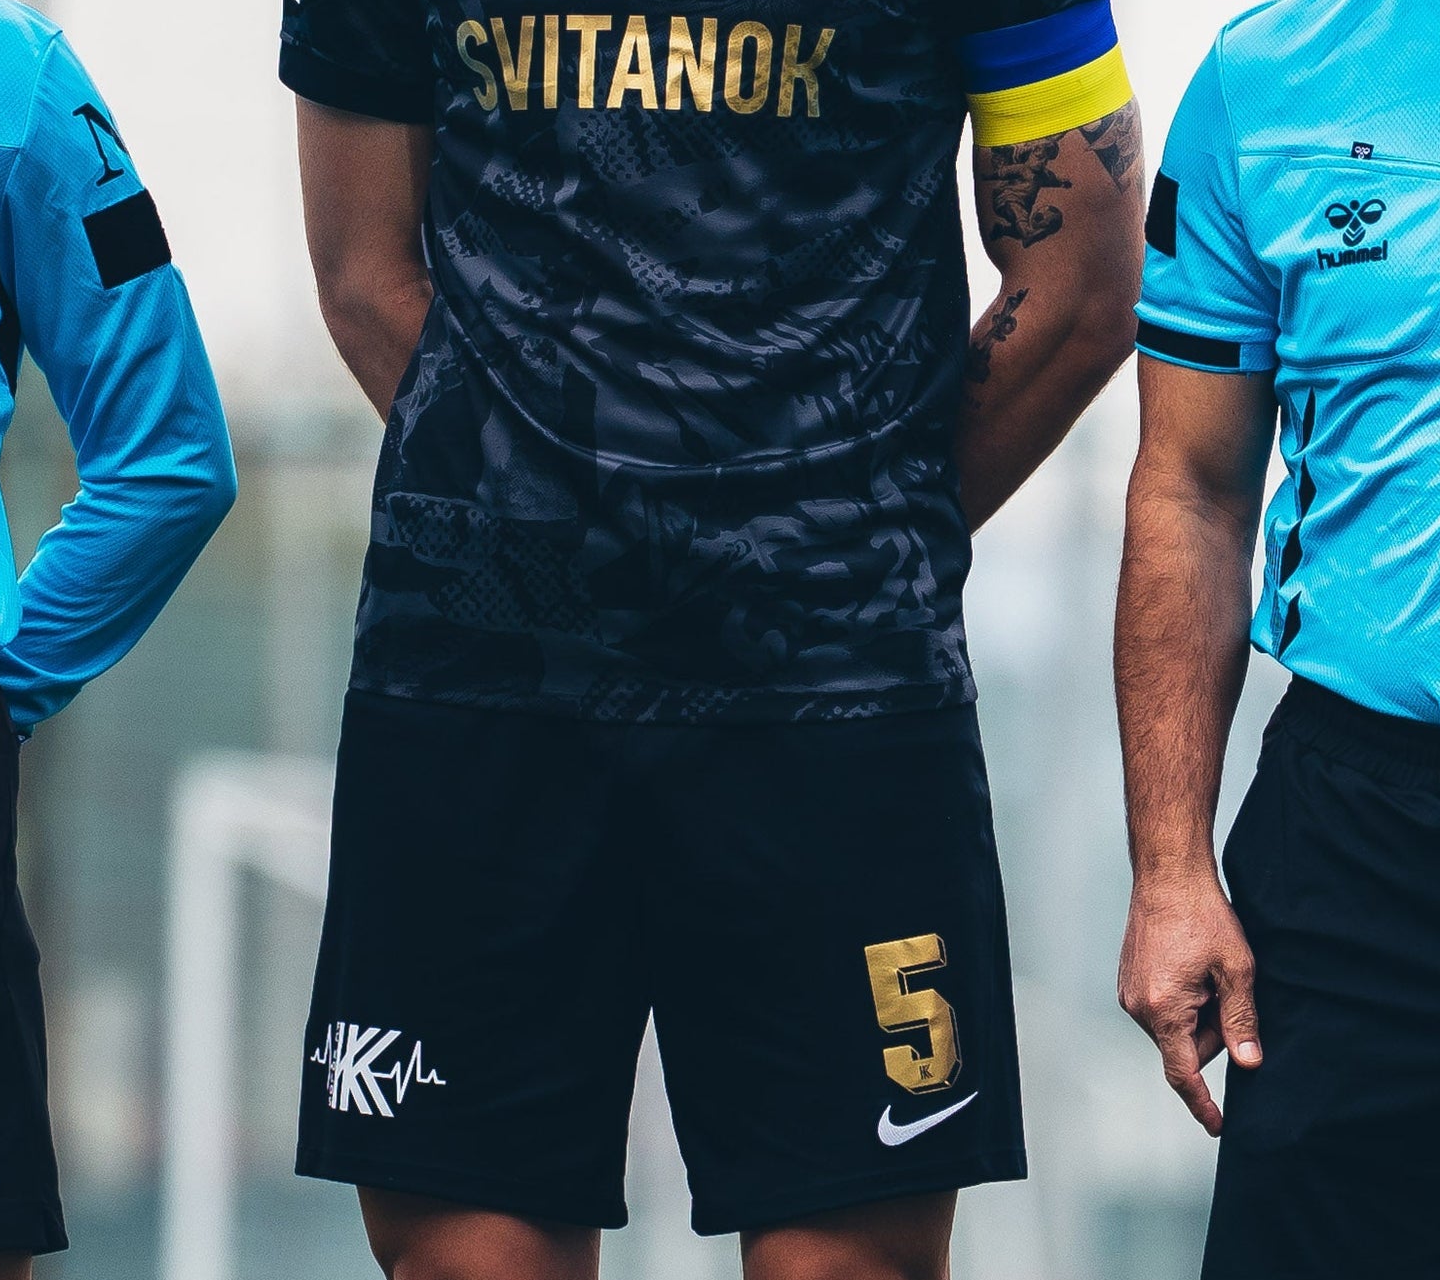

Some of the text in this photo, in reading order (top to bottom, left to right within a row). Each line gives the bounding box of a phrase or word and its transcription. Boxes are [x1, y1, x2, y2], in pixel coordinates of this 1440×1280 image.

[456, 14, 836, 119] SVITANOK
[1316, 239, 1388, 270] hummel
[865, 933, 963, 1095] 5
